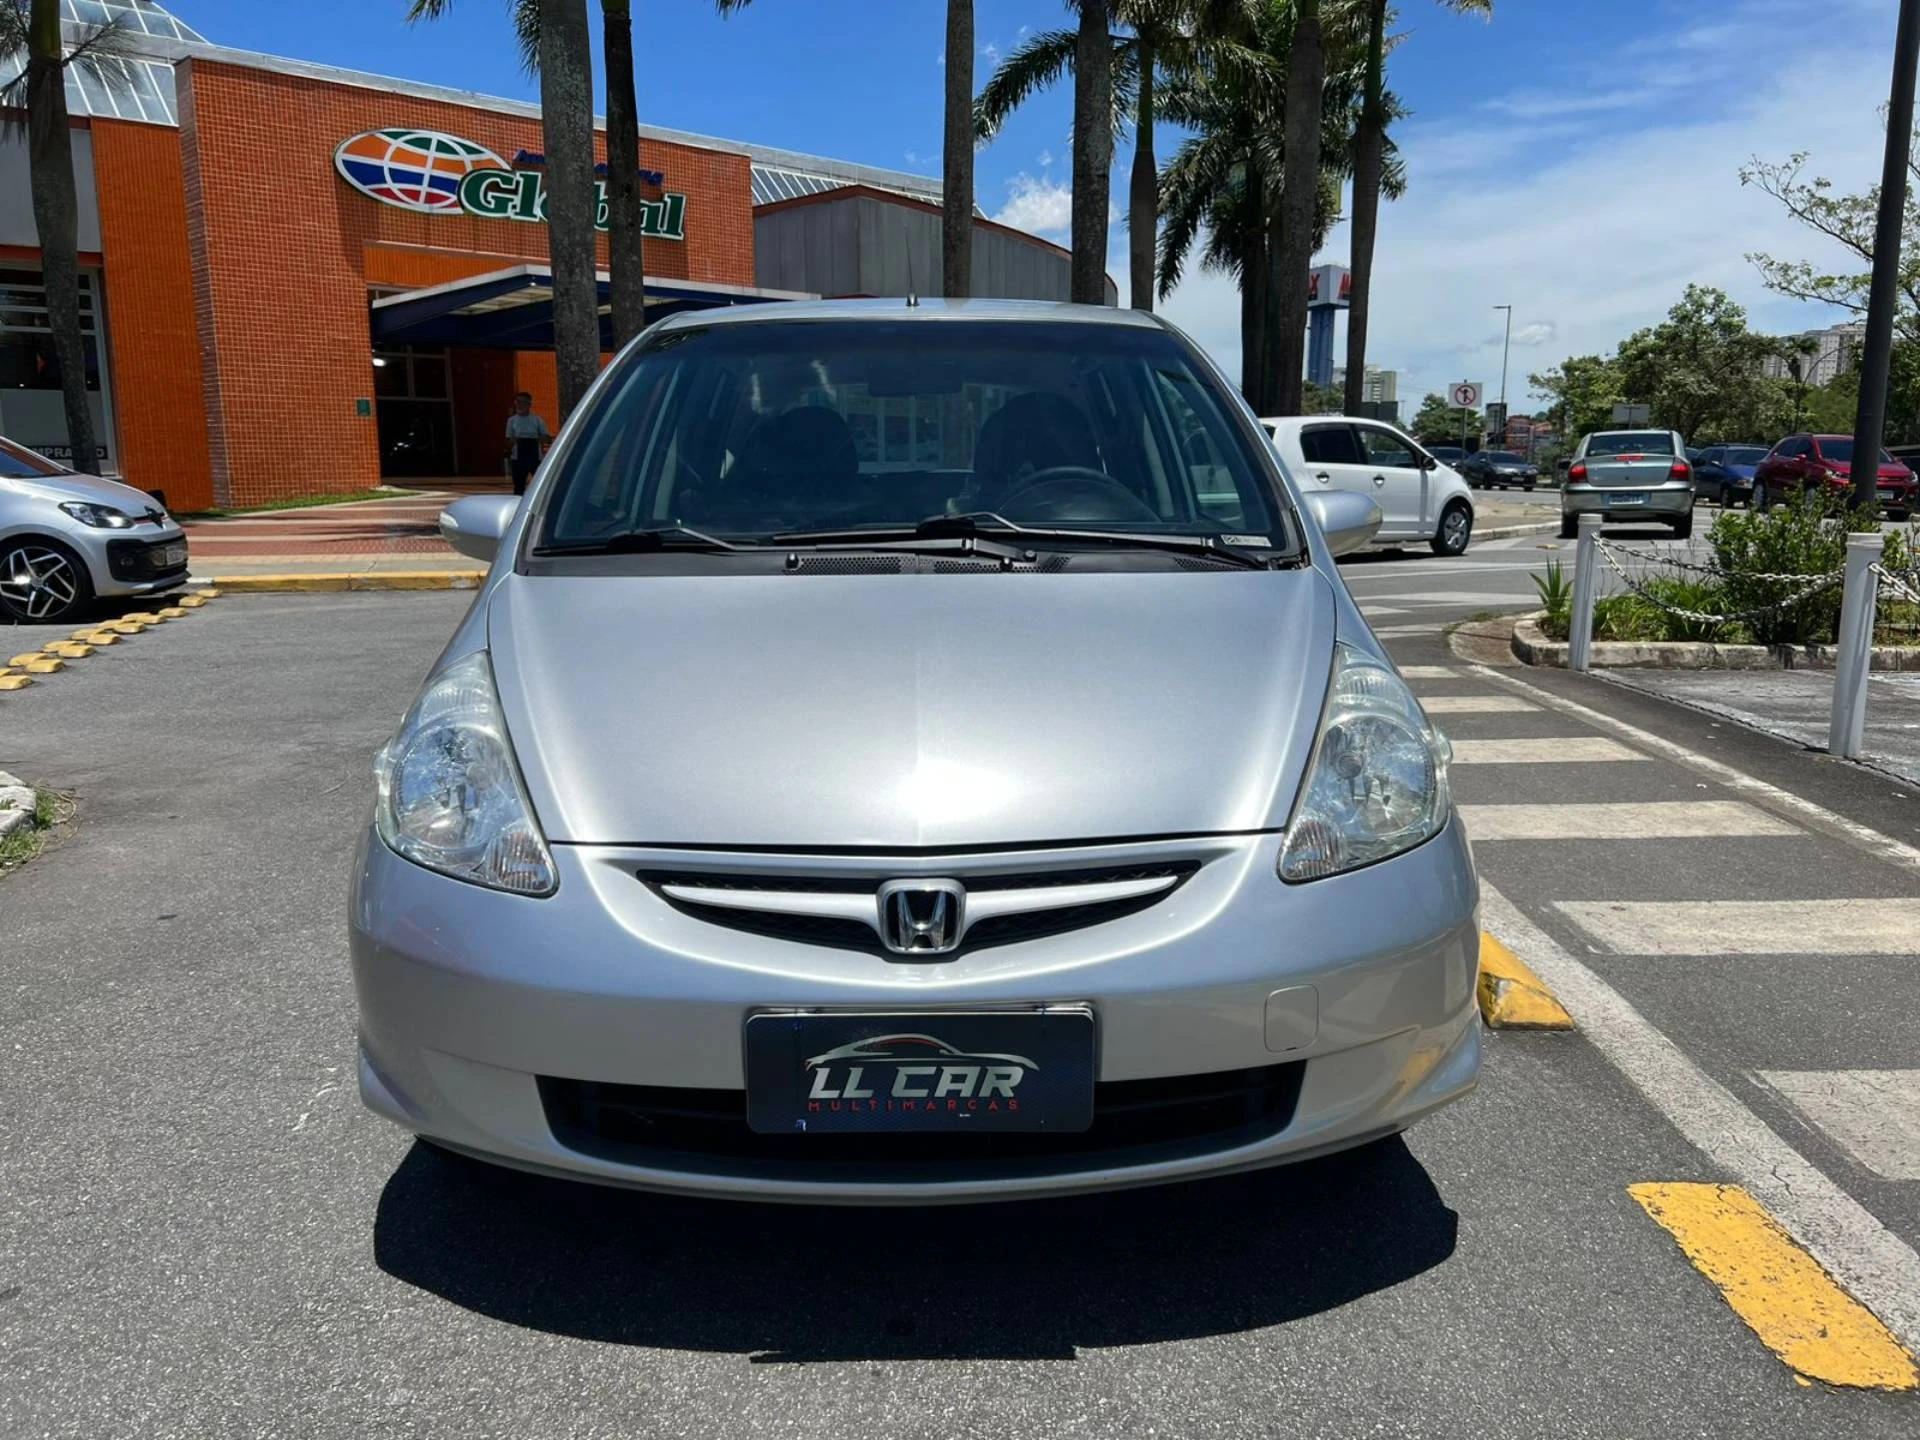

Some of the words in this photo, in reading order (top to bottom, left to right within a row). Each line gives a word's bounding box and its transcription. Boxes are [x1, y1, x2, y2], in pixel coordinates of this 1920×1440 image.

[460, 169, 687, 240] Glal
[808, 1067, 874, 1099] LL
[890, 1066, 1025, 1098] CAR
[808, 1100, 1018, 1112] MULTIMARCAS
